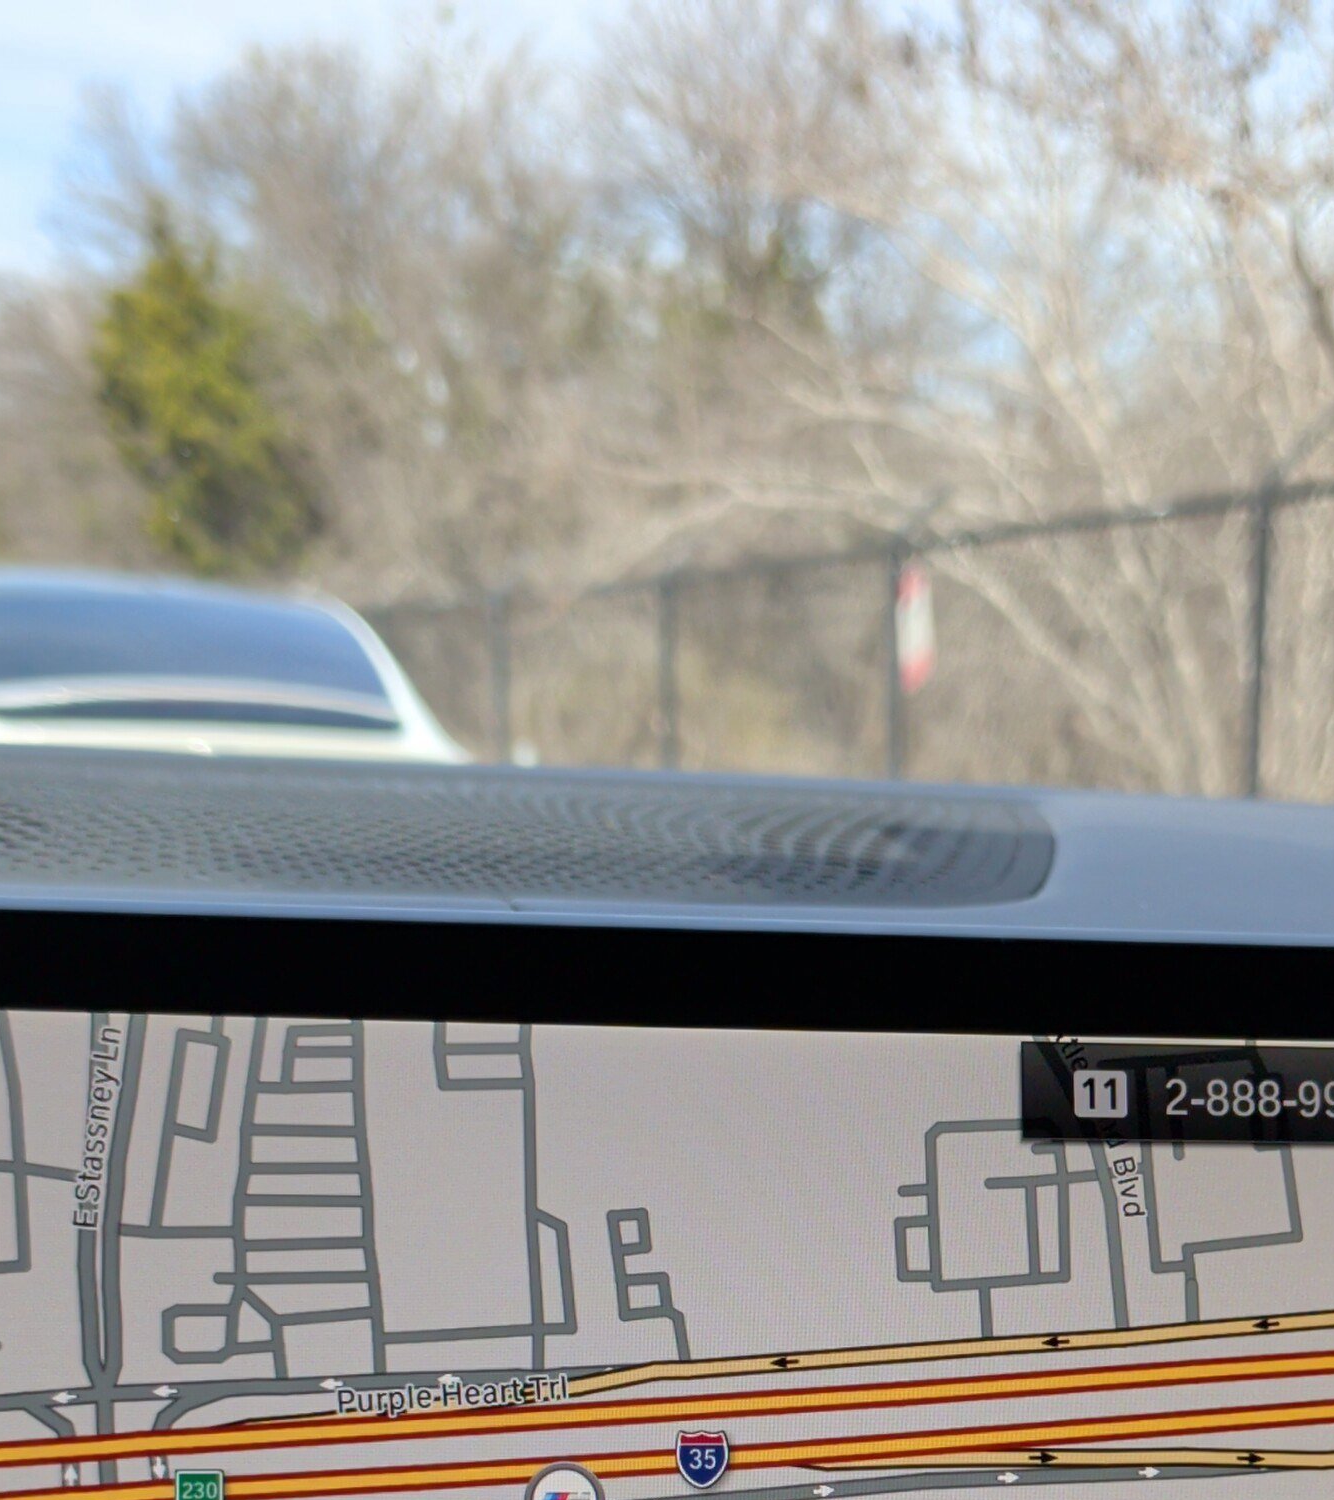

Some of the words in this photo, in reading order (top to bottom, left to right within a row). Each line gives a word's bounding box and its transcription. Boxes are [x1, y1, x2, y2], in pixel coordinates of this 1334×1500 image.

[93, 1027, 122, 1062] Ln
[1080, 1076, 1119, 1111] 11
[74, 1068, 122, 1204] Stassney
[1112, 1156, 1146, 1219] Blvd
[72, 1209, 99, 1229] E
[337, 1384, 432, 1416] Purple
[442, 1378, 524, 1407] Heart
[528, 1374, 569, 1401] Trl
[688, 1448, 717, 1470] 35
[182, 1480, 218, 1500] 230
